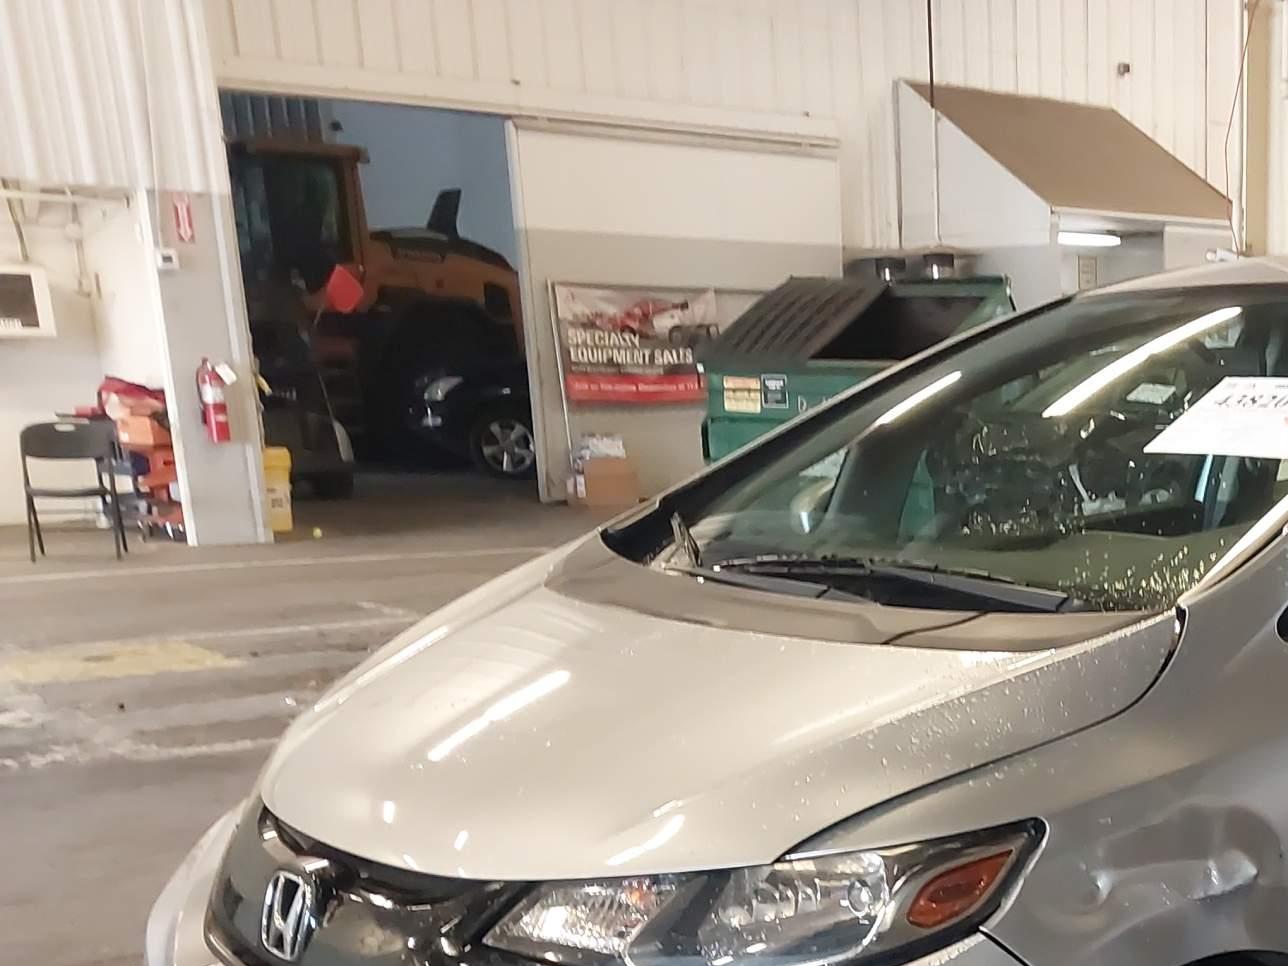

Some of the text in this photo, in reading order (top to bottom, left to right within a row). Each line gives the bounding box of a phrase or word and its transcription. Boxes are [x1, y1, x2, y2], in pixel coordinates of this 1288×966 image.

[568, 327, 640, 348] SPECIALTY
[569, 347, 693, 365] EQUIPMENT SALES
